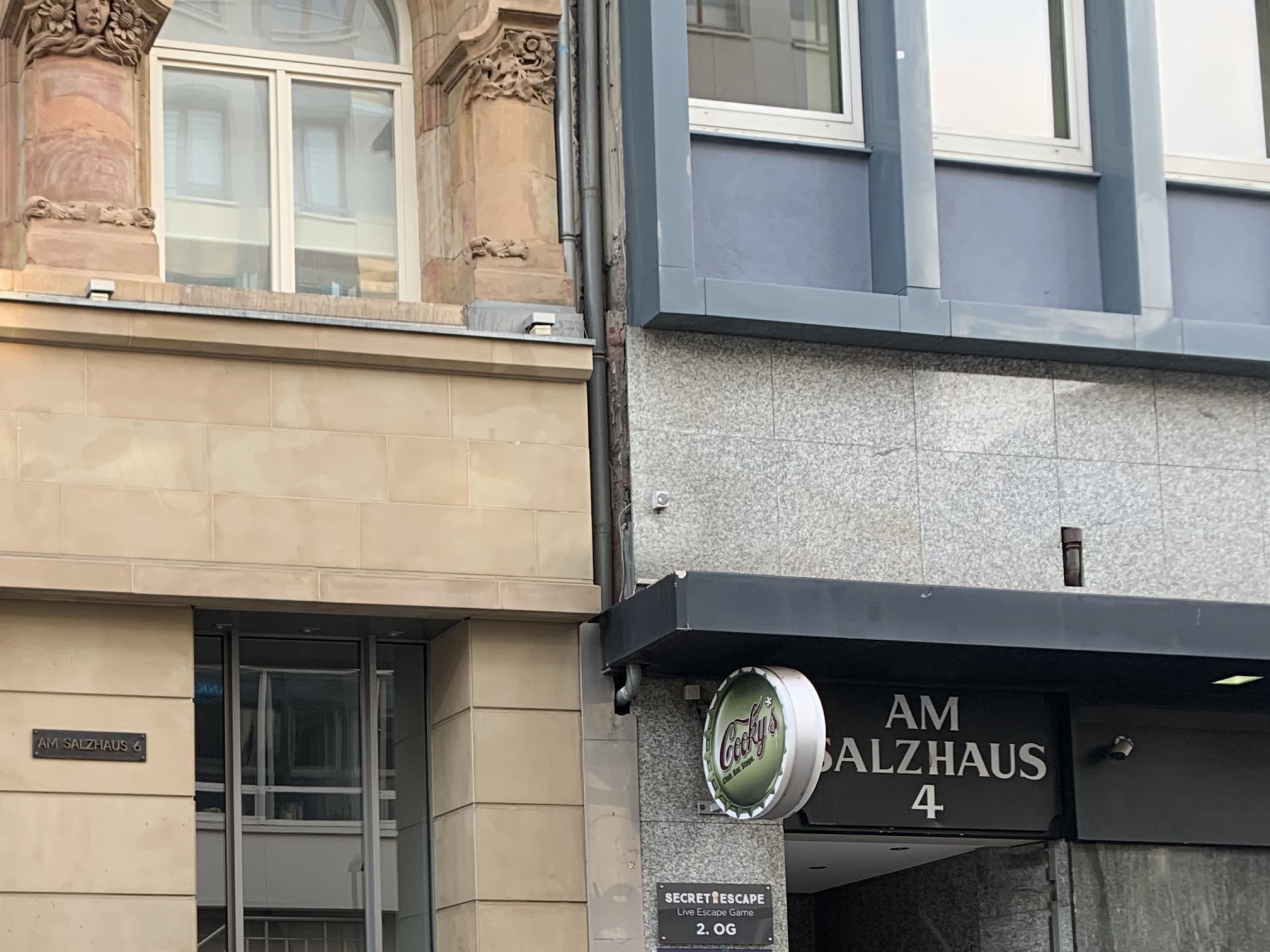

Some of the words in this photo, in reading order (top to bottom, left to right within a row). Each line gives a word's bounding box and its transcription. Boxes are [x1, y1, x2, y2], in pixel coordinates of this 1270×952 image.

[885, 693, 960, 732] AM
[38, 737, 59, 749] AM
[63, 738, 128, 752] SALZHAUS
[133, 741, 142, 752] 6
[910, 784, 944, 819] 4
[664, 892, 711, 904] SECRET
[719, 893, 765, 905] ESCAPE
[677, 907, 695, 917] Live
[696, 907, 727, 918] Escape
[729, 908, 754, 917] Game
[696, 922, 710, 936] 2.
[713, 922, 737, 936] OG
